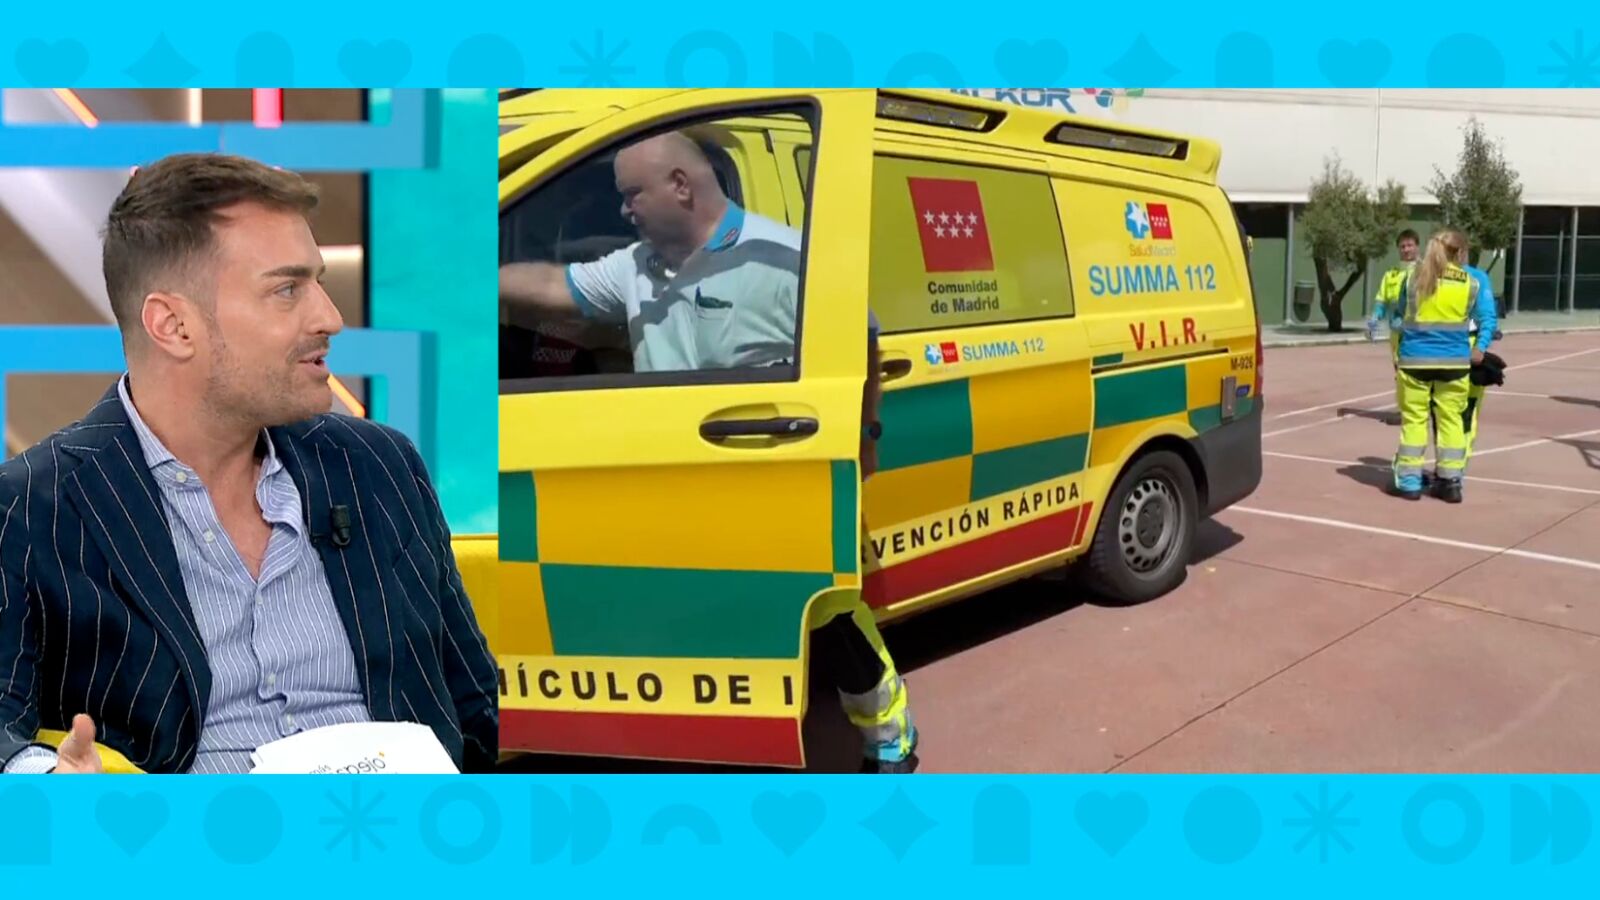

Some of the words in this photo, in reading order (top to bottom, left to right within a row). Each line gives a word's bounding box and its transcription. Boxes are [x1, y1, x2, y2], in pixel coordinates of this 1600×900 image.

[928, 279, 998, 294] Comunidad
[1088, 264, 1180, 295] SUMMA
[1184, 263, 1216, 291] 112
[930, 299, 948, 313] de
[952, 296, 999, 312] Madrid
[962, 340, 1020, 361] SUMMA
[1023, 337, 1045, 353] 112
[1129, 317, 1206, 351] V.I.R.
[1003, 481, 1080, 521] RÁPIDA
[693, 673, 752, 706] DE
